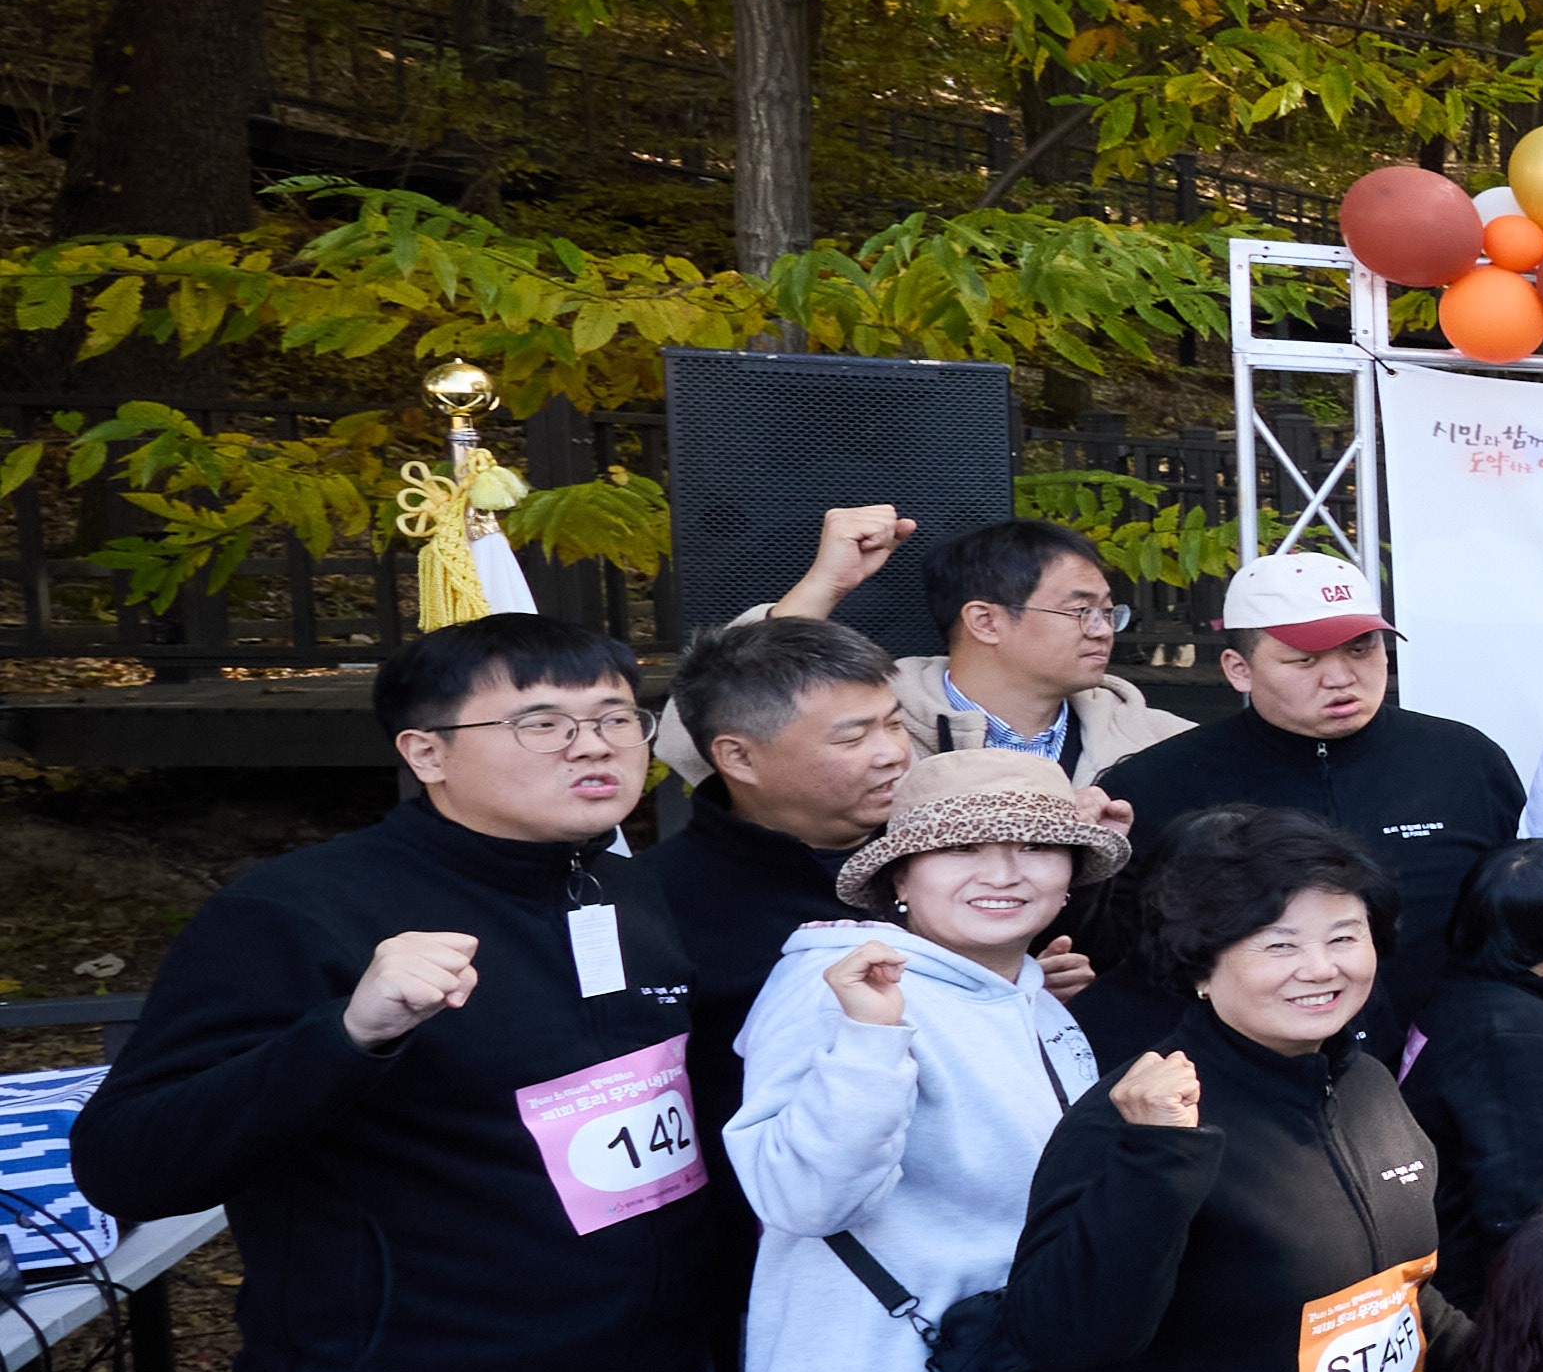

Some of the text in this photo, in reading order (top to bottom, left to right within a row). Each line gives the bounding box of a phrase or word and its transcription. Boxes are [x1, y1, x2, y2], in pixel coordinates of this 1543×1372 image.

[1432, 420, 1502, 447] 시민과
[1469, 451, 1534, 477] 도약하는
[1320, 585, 1353, 603] CAT
[606, 1105, 692, 1170] 142
